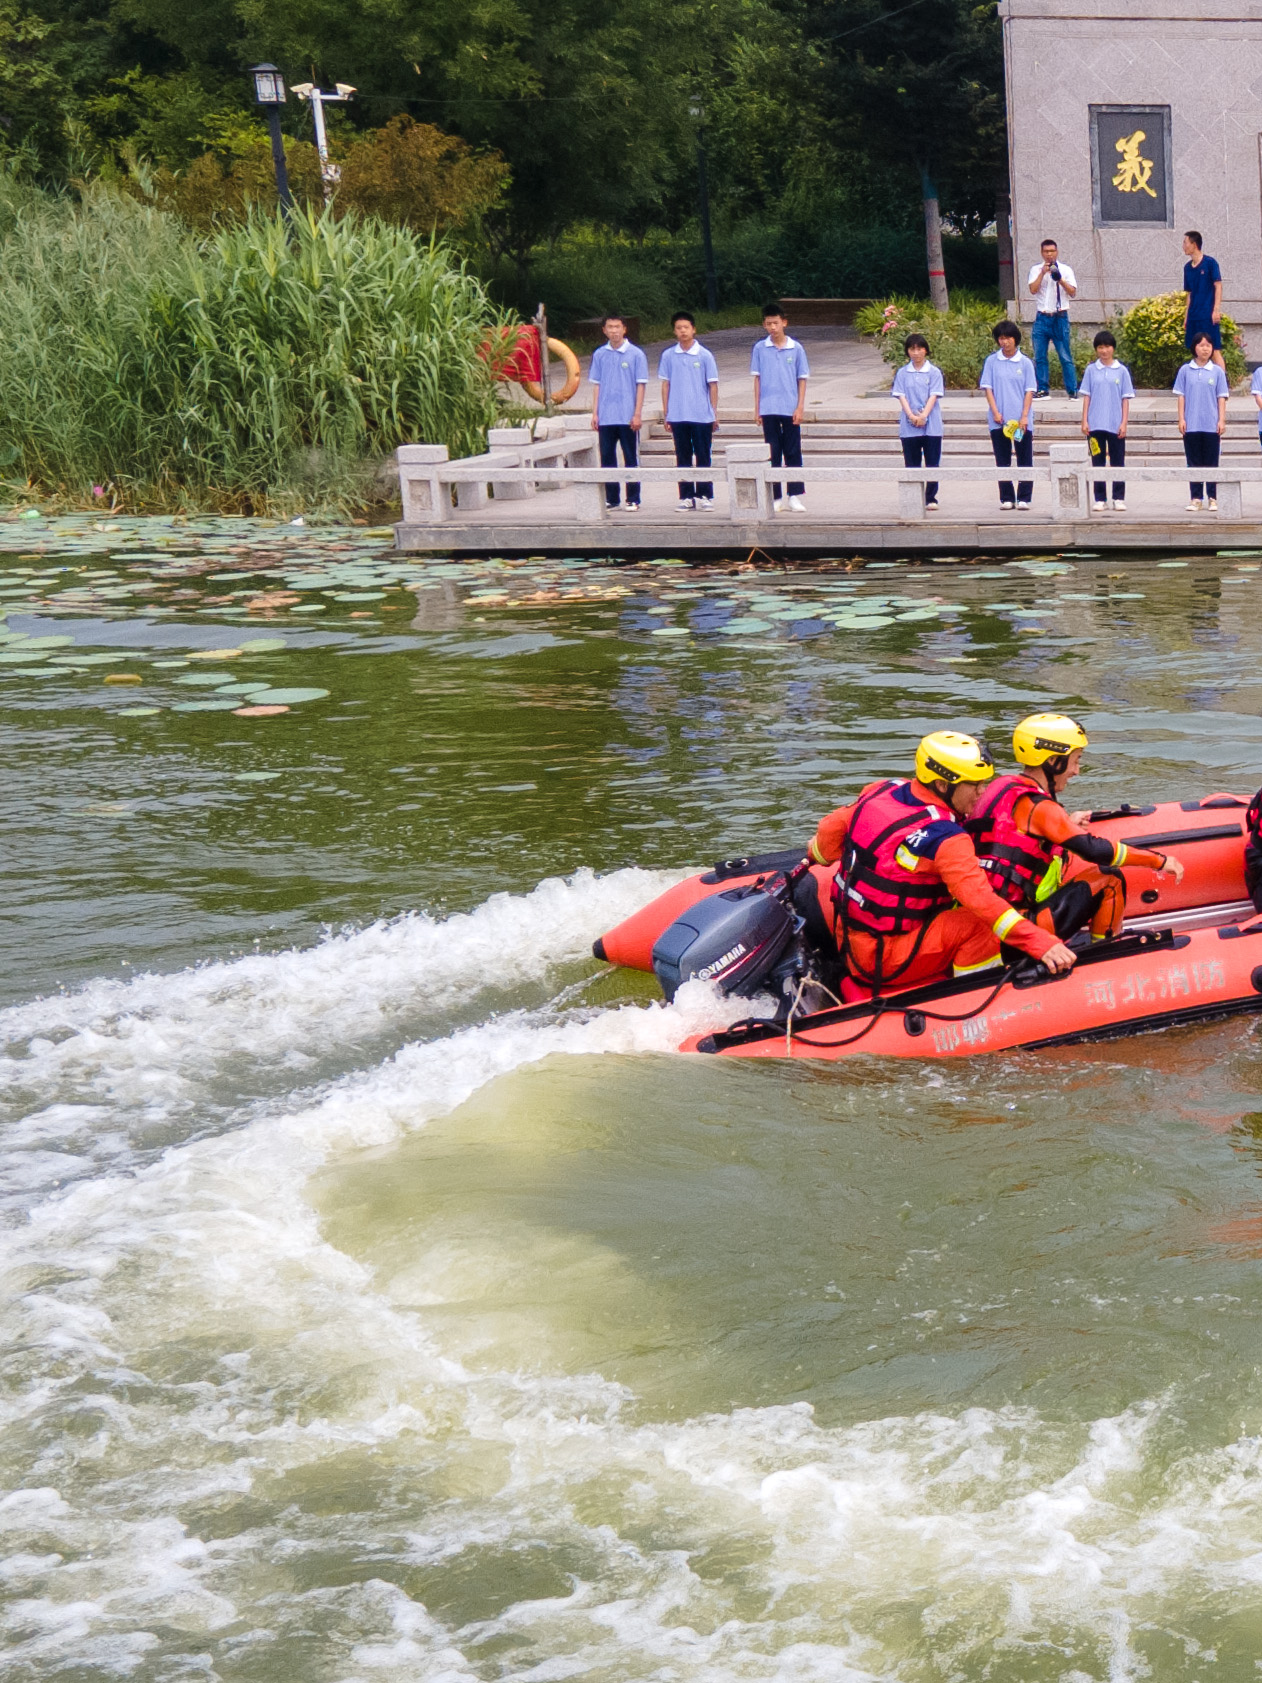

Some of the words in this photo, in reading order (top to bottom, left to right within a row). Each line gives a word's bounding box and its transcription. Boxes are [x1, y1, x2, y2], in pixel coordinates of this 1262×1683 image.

[1112, 130, 1157, 198] 義
[707, 943, 747, 974] YAMAHA
[1084, 960, 1225, 1010] 河北消防
